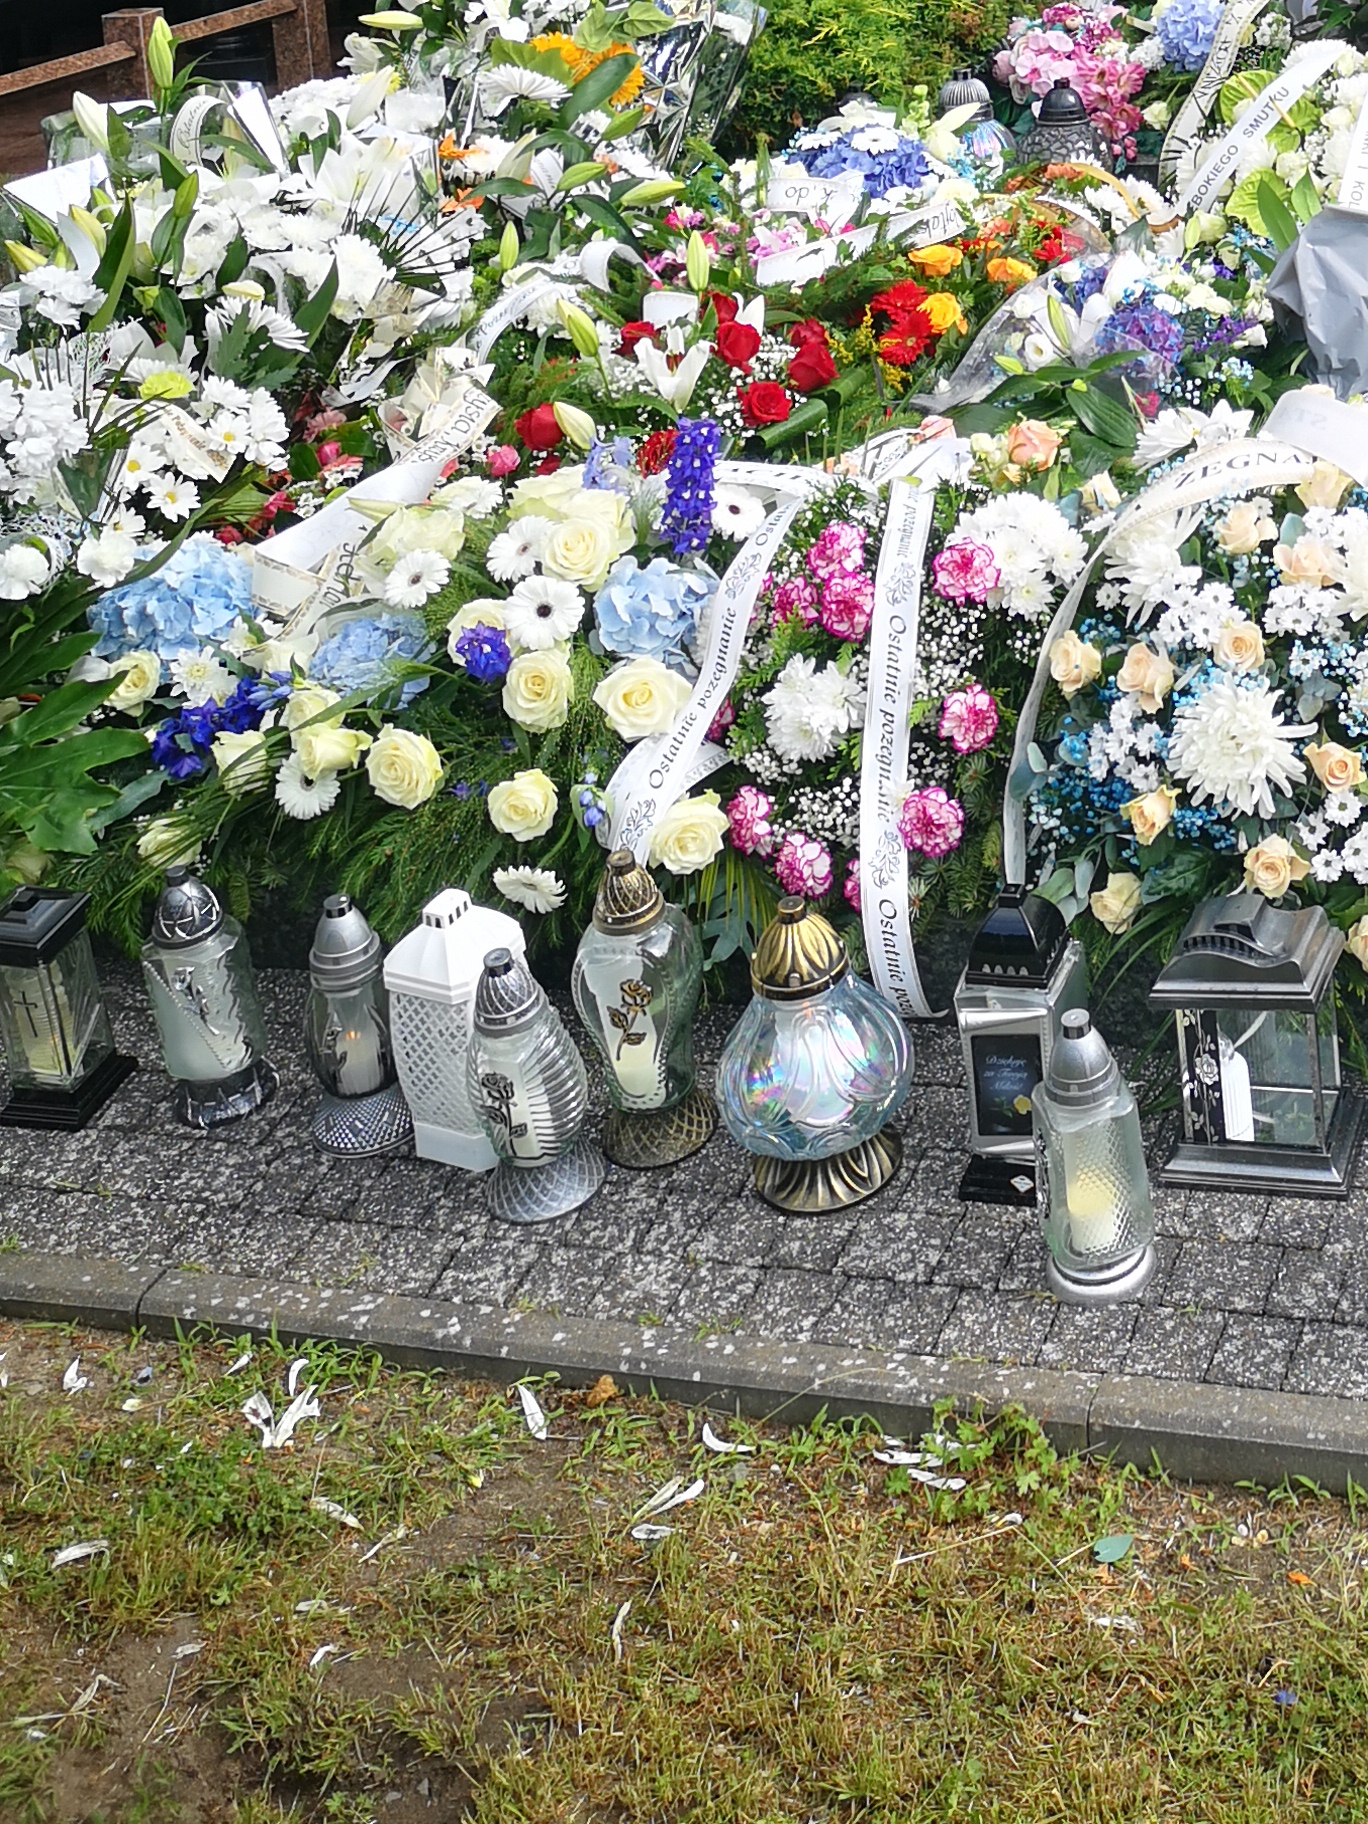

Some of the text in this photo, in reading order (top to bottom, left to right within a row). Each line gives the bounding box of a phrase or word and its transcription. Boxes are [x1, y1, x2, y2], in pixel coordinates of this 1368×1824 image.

[1189, 86, 1290, 209] BOKIEGO SMUTKU
[1348, 179, 1366, 210] KOL
[884, 614, 908, 705] Ostatnie
[648, 711, 699, 791] Ostatnie
[878, 898, 907, 984] Ostatnie
